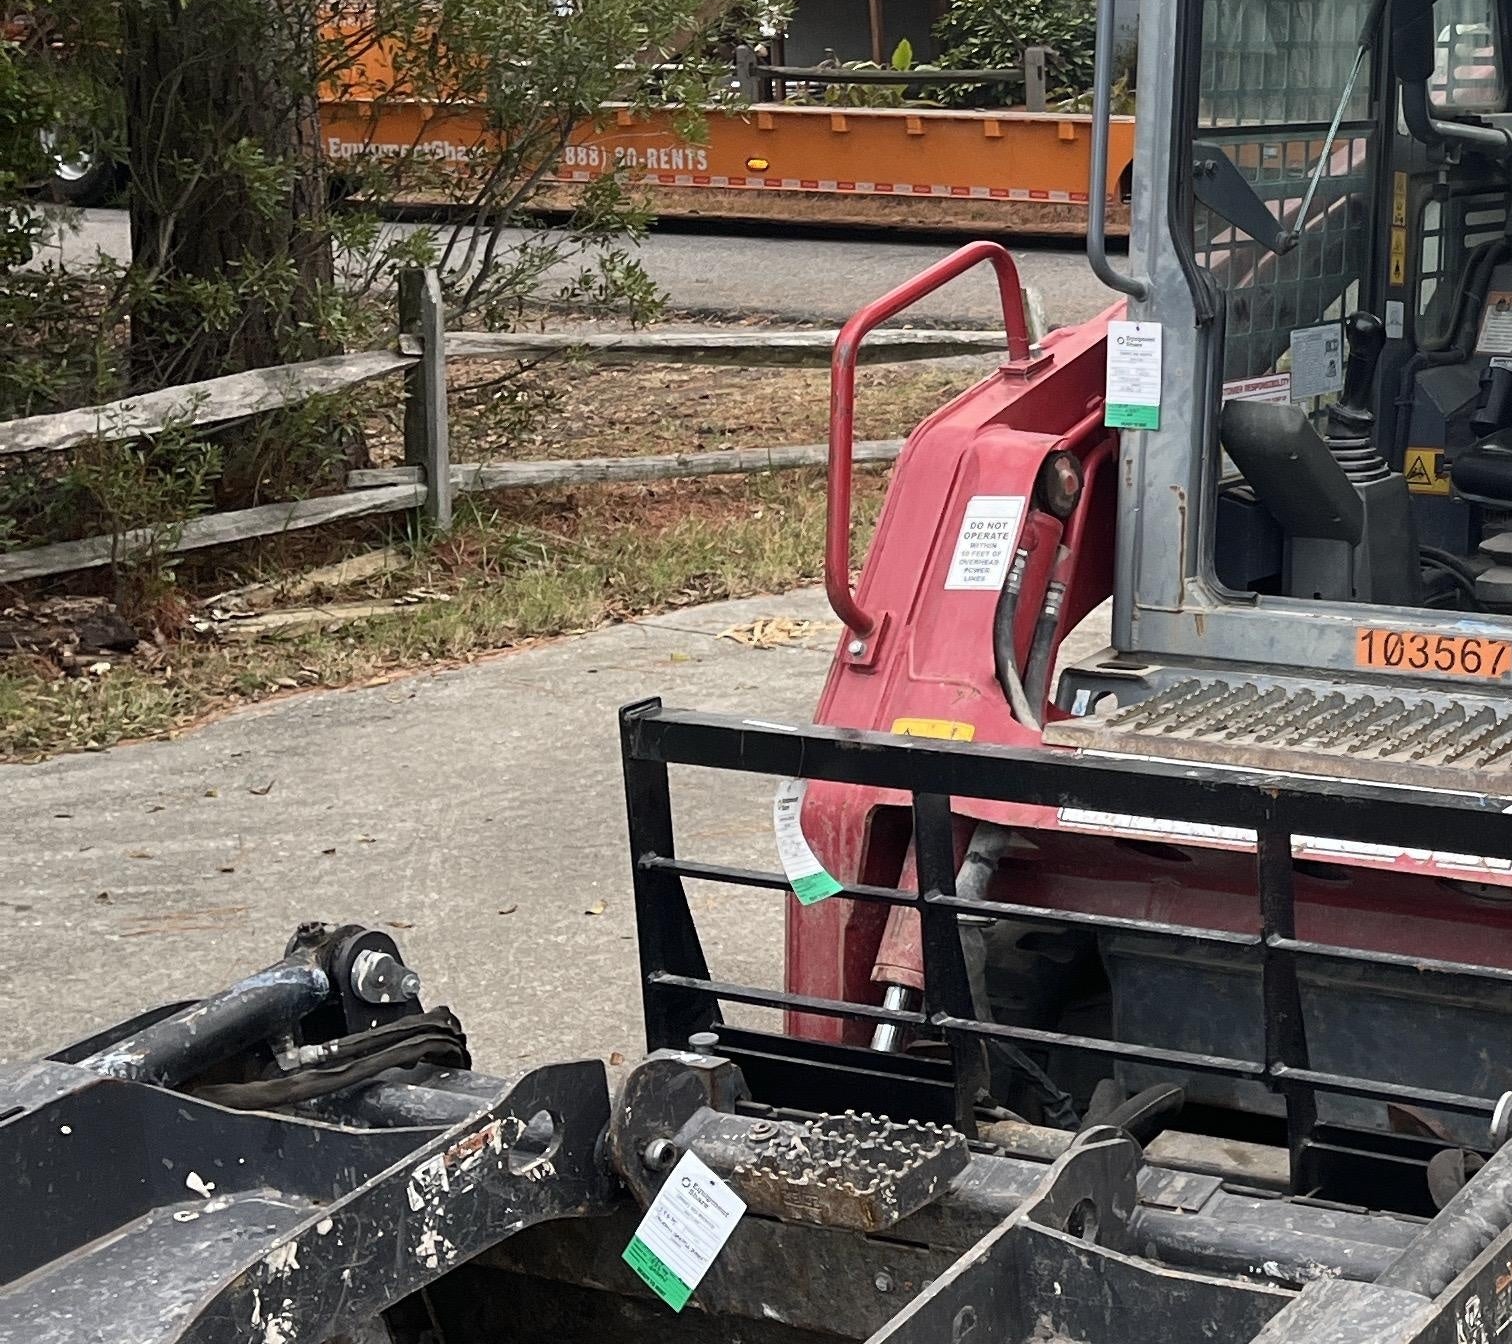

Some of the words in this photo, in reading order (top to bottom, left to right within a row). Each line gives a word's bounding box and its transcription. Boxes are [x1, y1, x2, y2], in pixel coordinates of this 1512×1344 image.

[970, 521, 984, 530] DO
[987, 521, 1009, 530] NOT
[964, 531, 1009, 541] OPERATE
[1360, 629, 1508, 675] 103567
